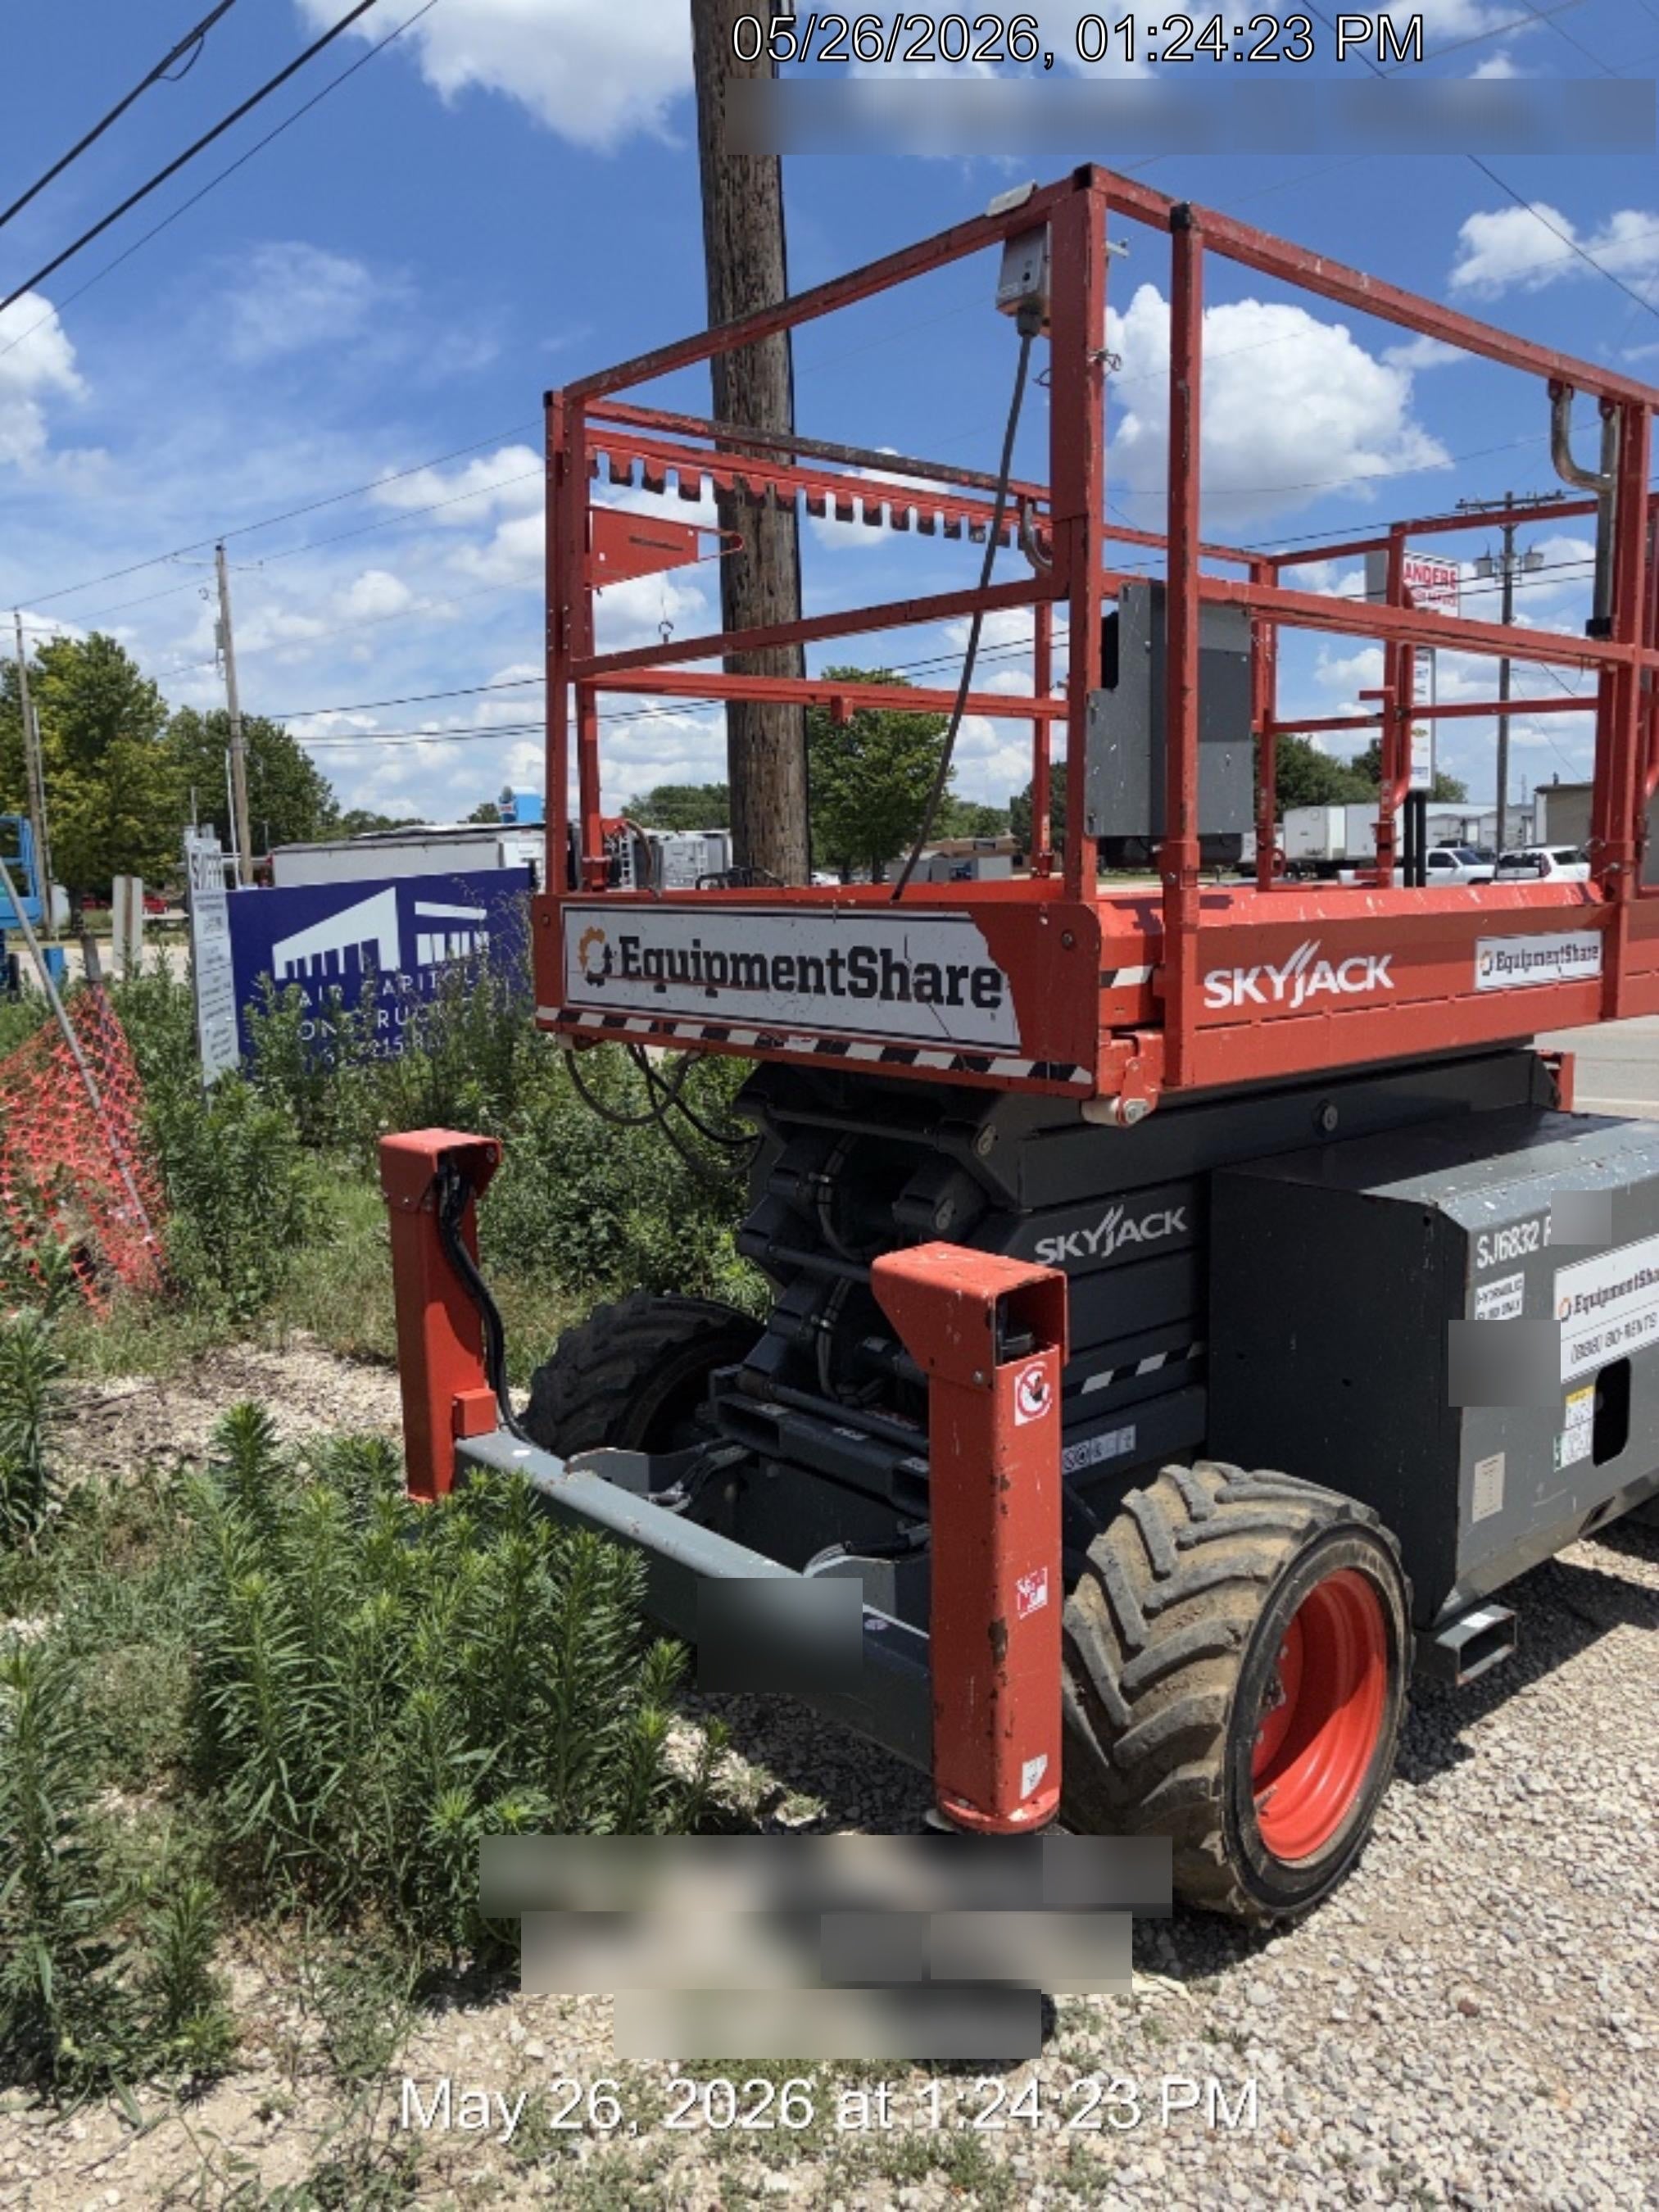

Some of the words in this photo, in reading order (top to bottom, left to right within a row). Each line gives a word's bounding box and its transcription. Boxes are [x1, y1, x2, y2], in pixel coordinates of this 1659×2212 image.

[1403, 561, 1457, 590] ANDERS
[619, 935, 1004, 1009] EquipmentShare
[1203, 938, 1394, 1009] SKYJACK
[1495, 942, 1600, 972] EquipmentShare
[1034, 1203, 1188, 1265] SKYJACK
[1476, 1219, 1539, 1269] SJ6832
